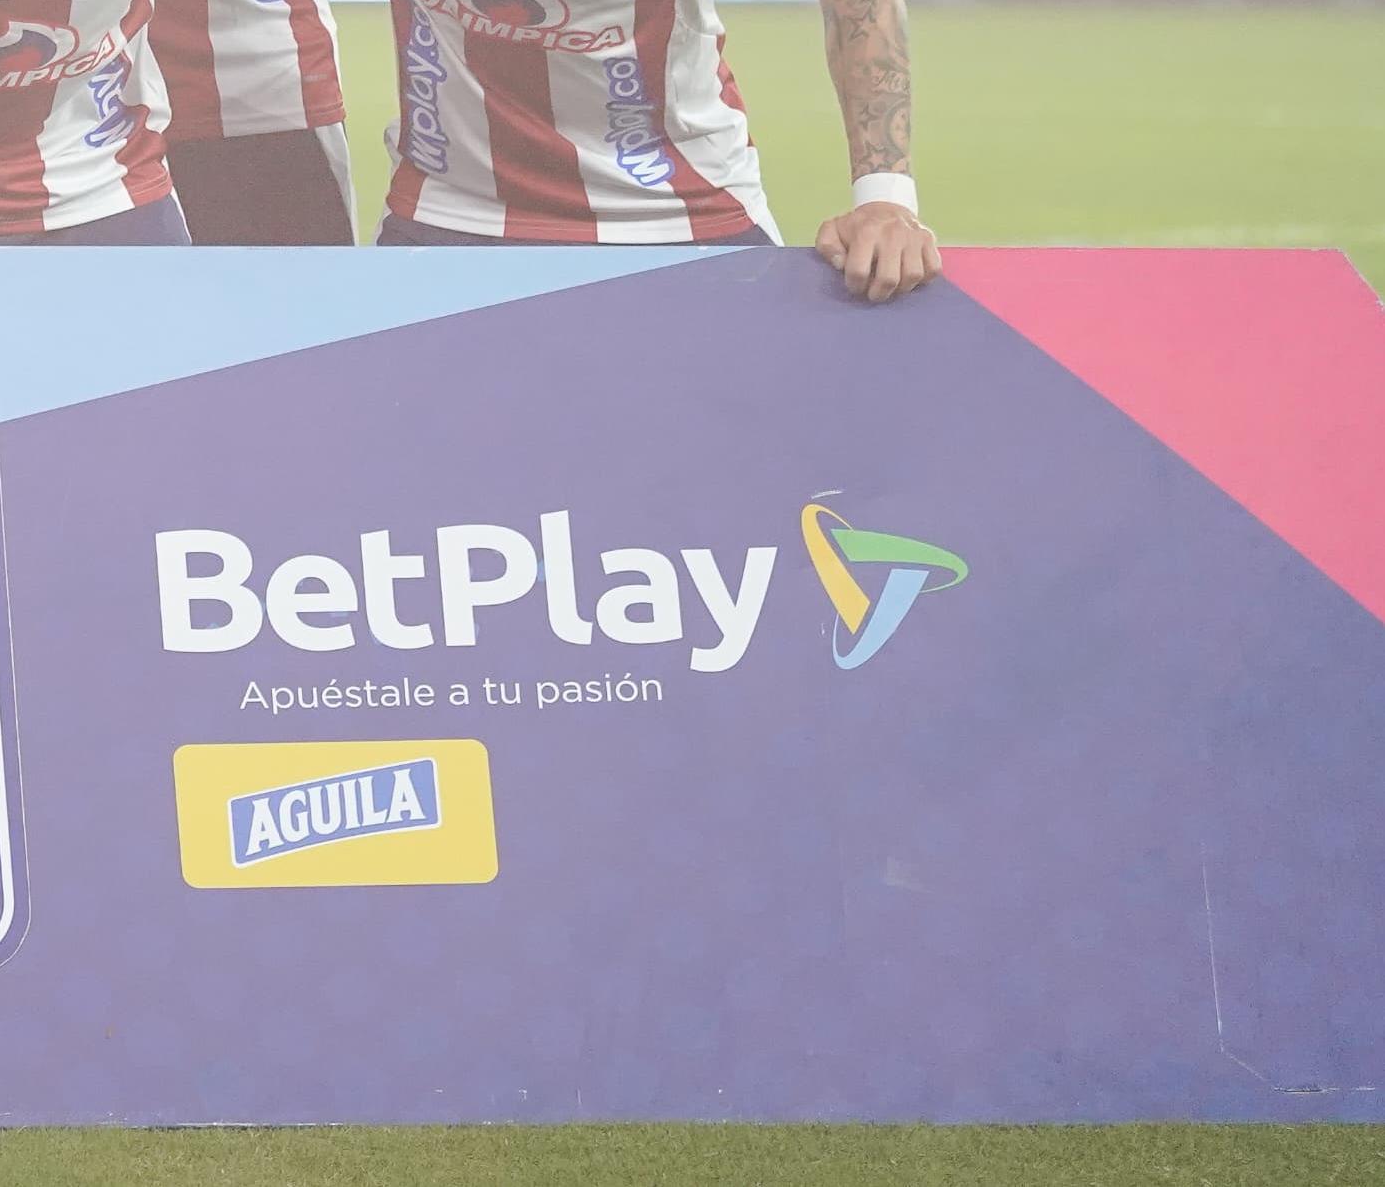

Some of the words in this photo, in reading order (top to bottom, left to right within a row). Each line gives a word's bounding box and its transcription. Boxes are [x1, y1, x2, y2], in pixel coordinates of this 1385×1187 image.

[154, 509, 778, 673] BetPlay
[239, 676, 436, 713] Apuéstale
[449, 682, 471, 706] a
[482, 676, 523, 705] tu
[536, 670, 664, 710] pasión
[244, 767, 426, 857] AGUILA
